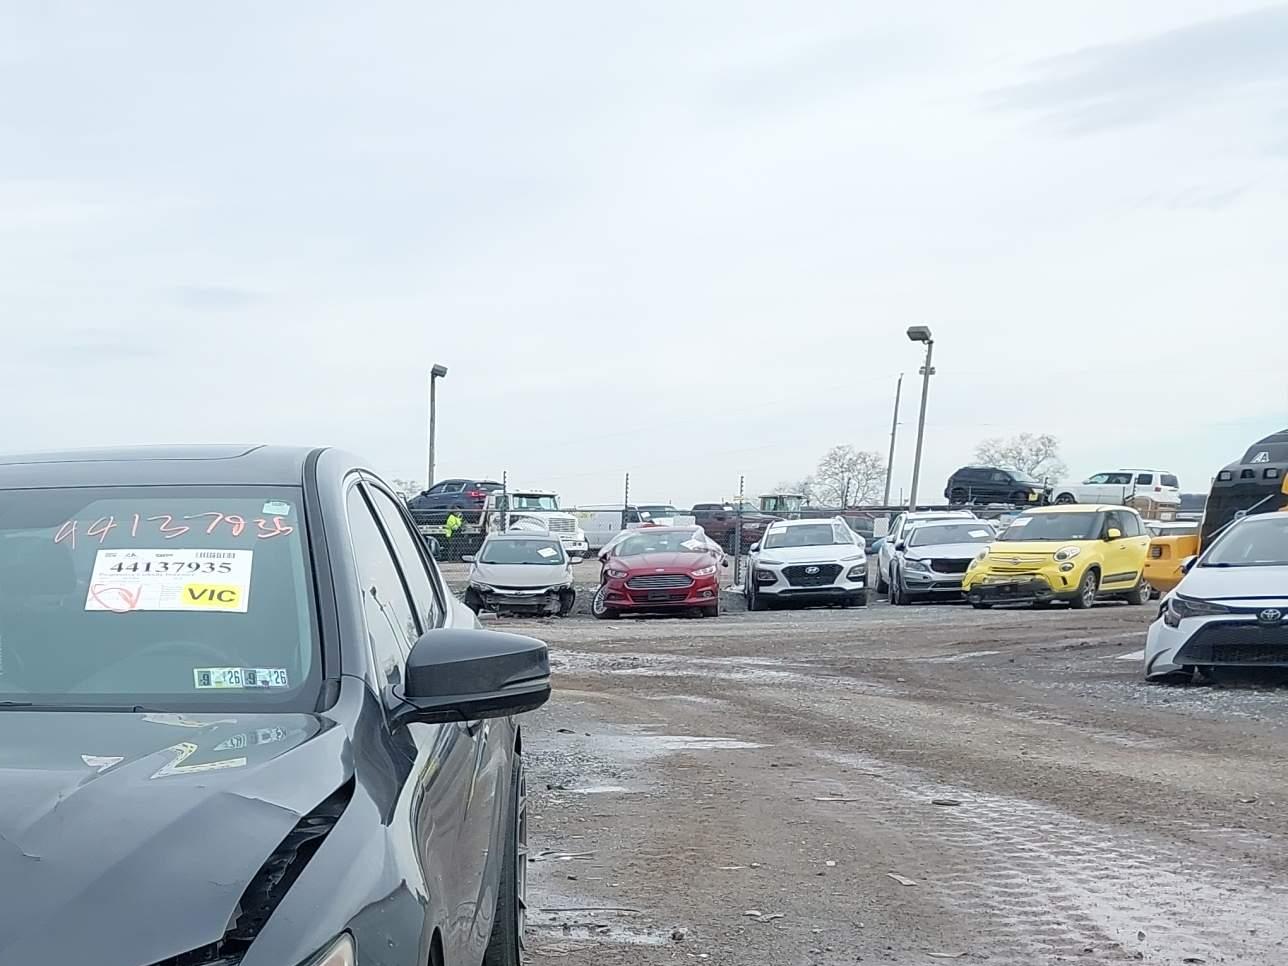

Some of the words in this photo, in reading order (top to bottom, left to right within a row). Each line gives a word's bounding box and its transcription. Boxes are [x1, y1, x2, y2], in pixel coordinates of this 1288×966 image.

[110, 561, 232, 574] 44137935
[188, 588, 236, 603] VIC
[226, 670, 241, 684] 26
[273, 670, 287, 684] 26
